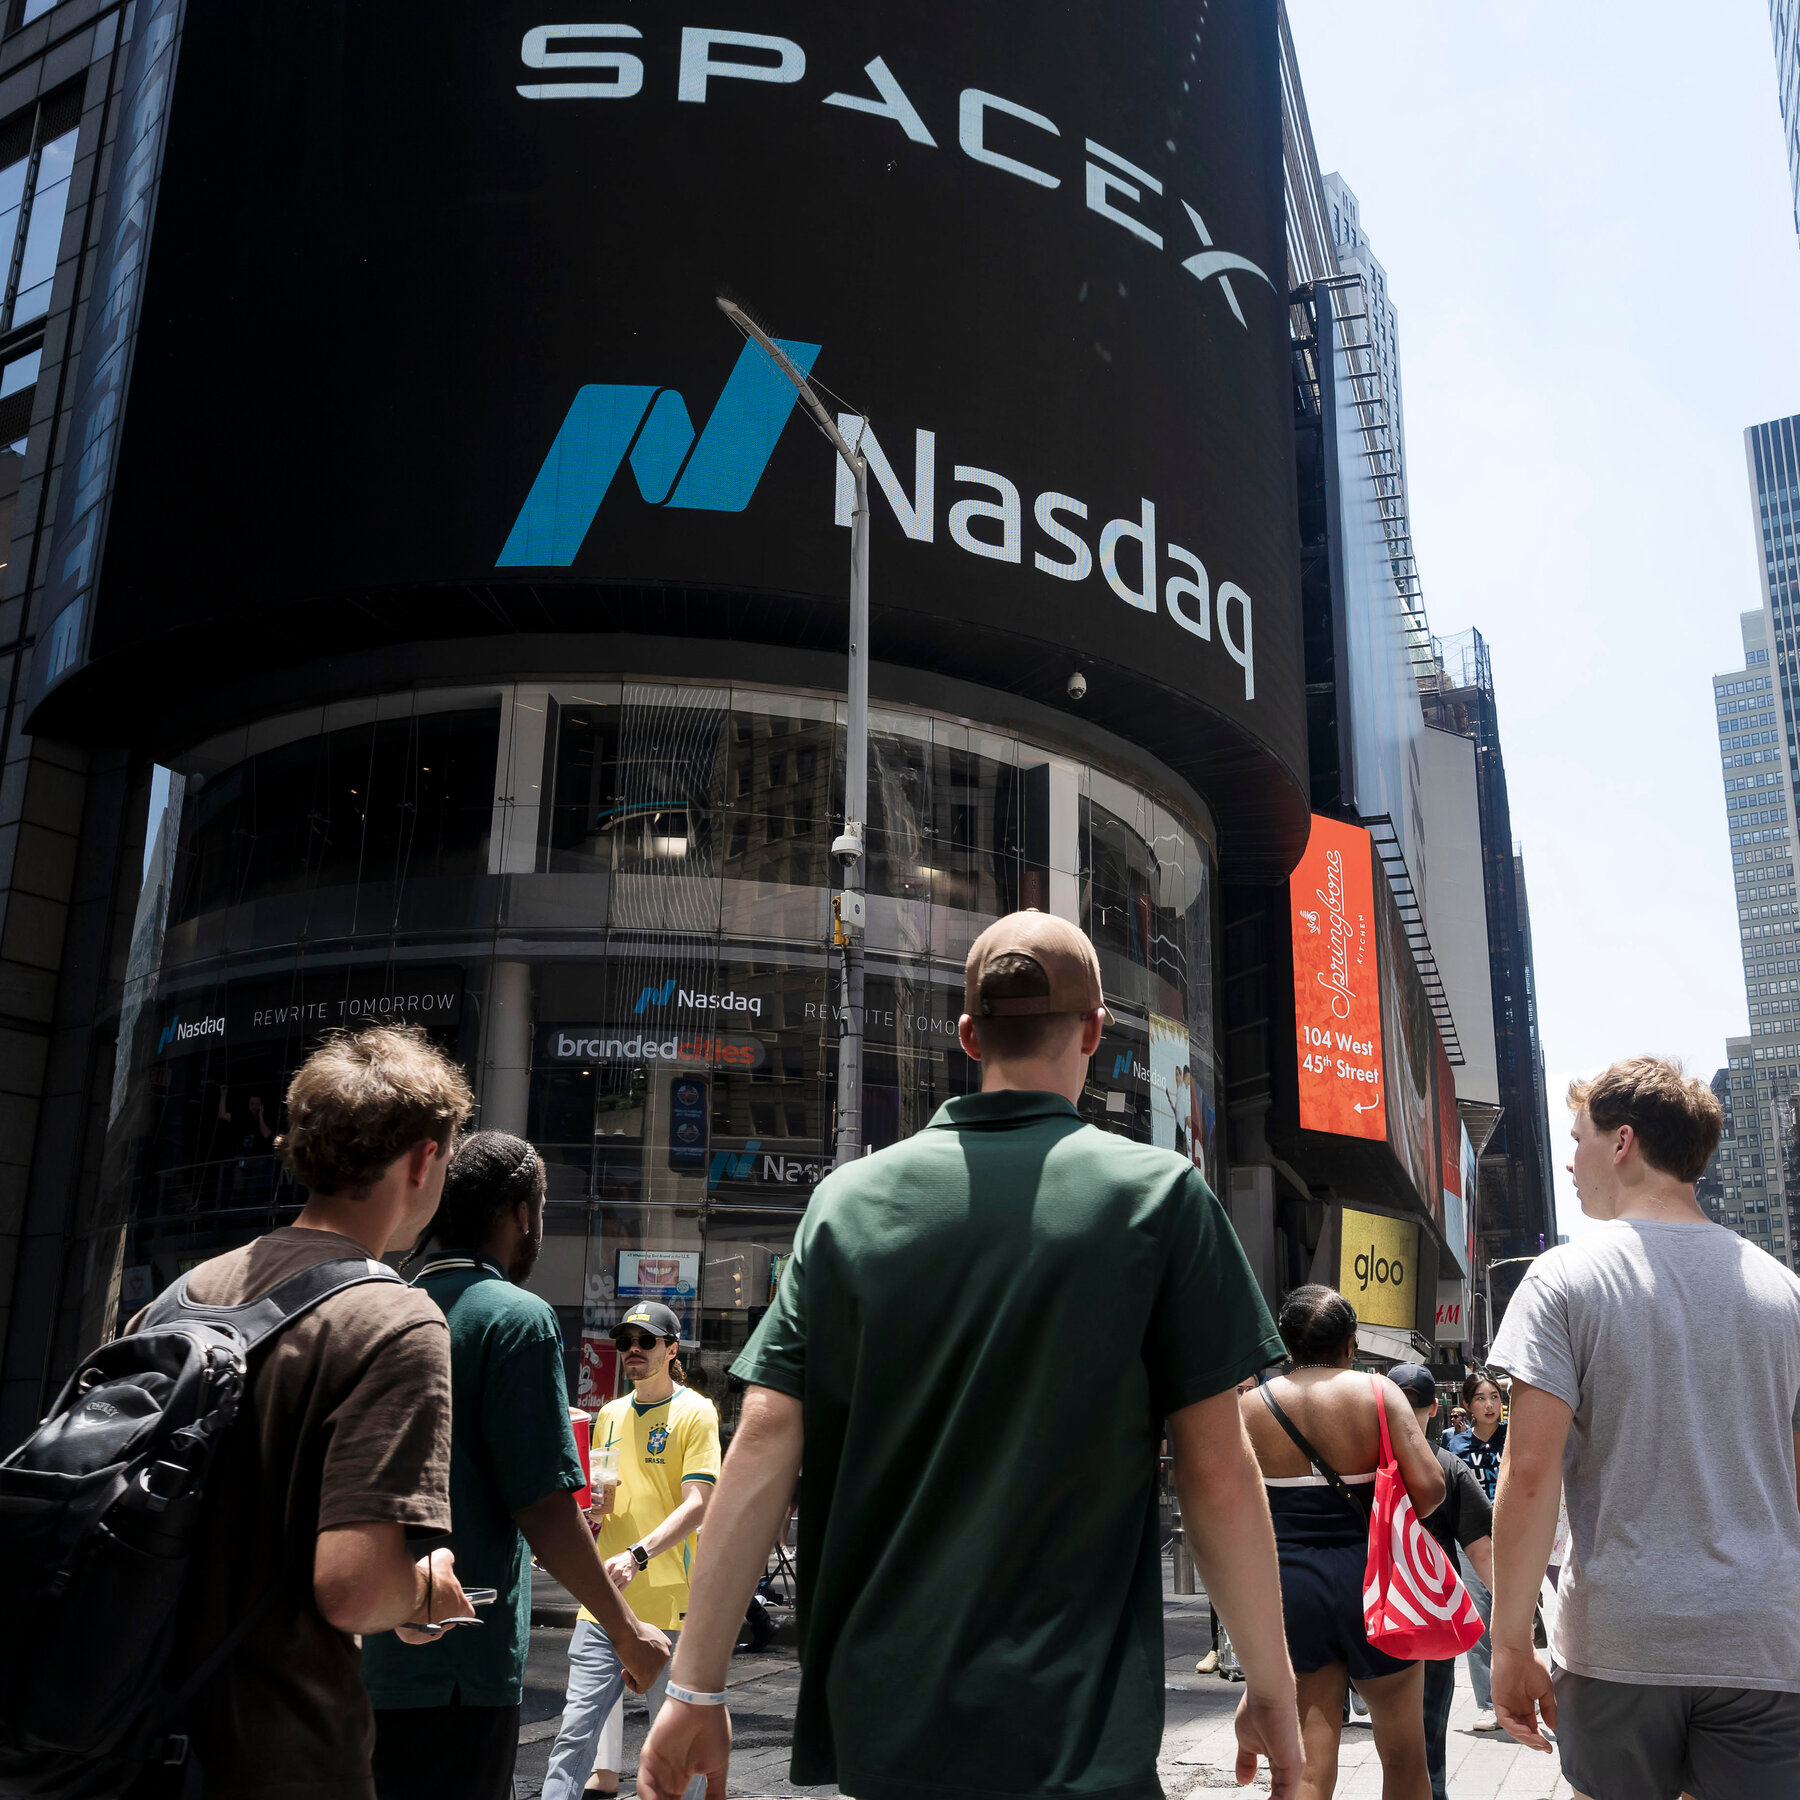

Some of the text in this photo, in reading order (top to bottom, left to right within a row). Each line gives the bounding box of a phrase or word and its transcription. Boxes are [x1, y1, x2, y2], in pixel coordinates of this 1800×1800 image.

[515, 24, 1278, 330] SPACEX
[834, 412, 1255, 700] Nasdaq
[1317, 850, 1356, 1019] Springbone
[1337, 914, 1364, 965] KITCHEN
[253, 993, 455, 1026] REWRITE TOMORROW
[677, 989, 762, 1017] Nasdaq
[804, 1002, 894, 1027] REWITE
[177, 1016, 226, 1042] Nasdaq
[1303, 1025, 1374, 1057] 104 West
[1303, 1053, 1380, 1084] 45th Street
[1354, 1244, 1404, 1291] gloo
